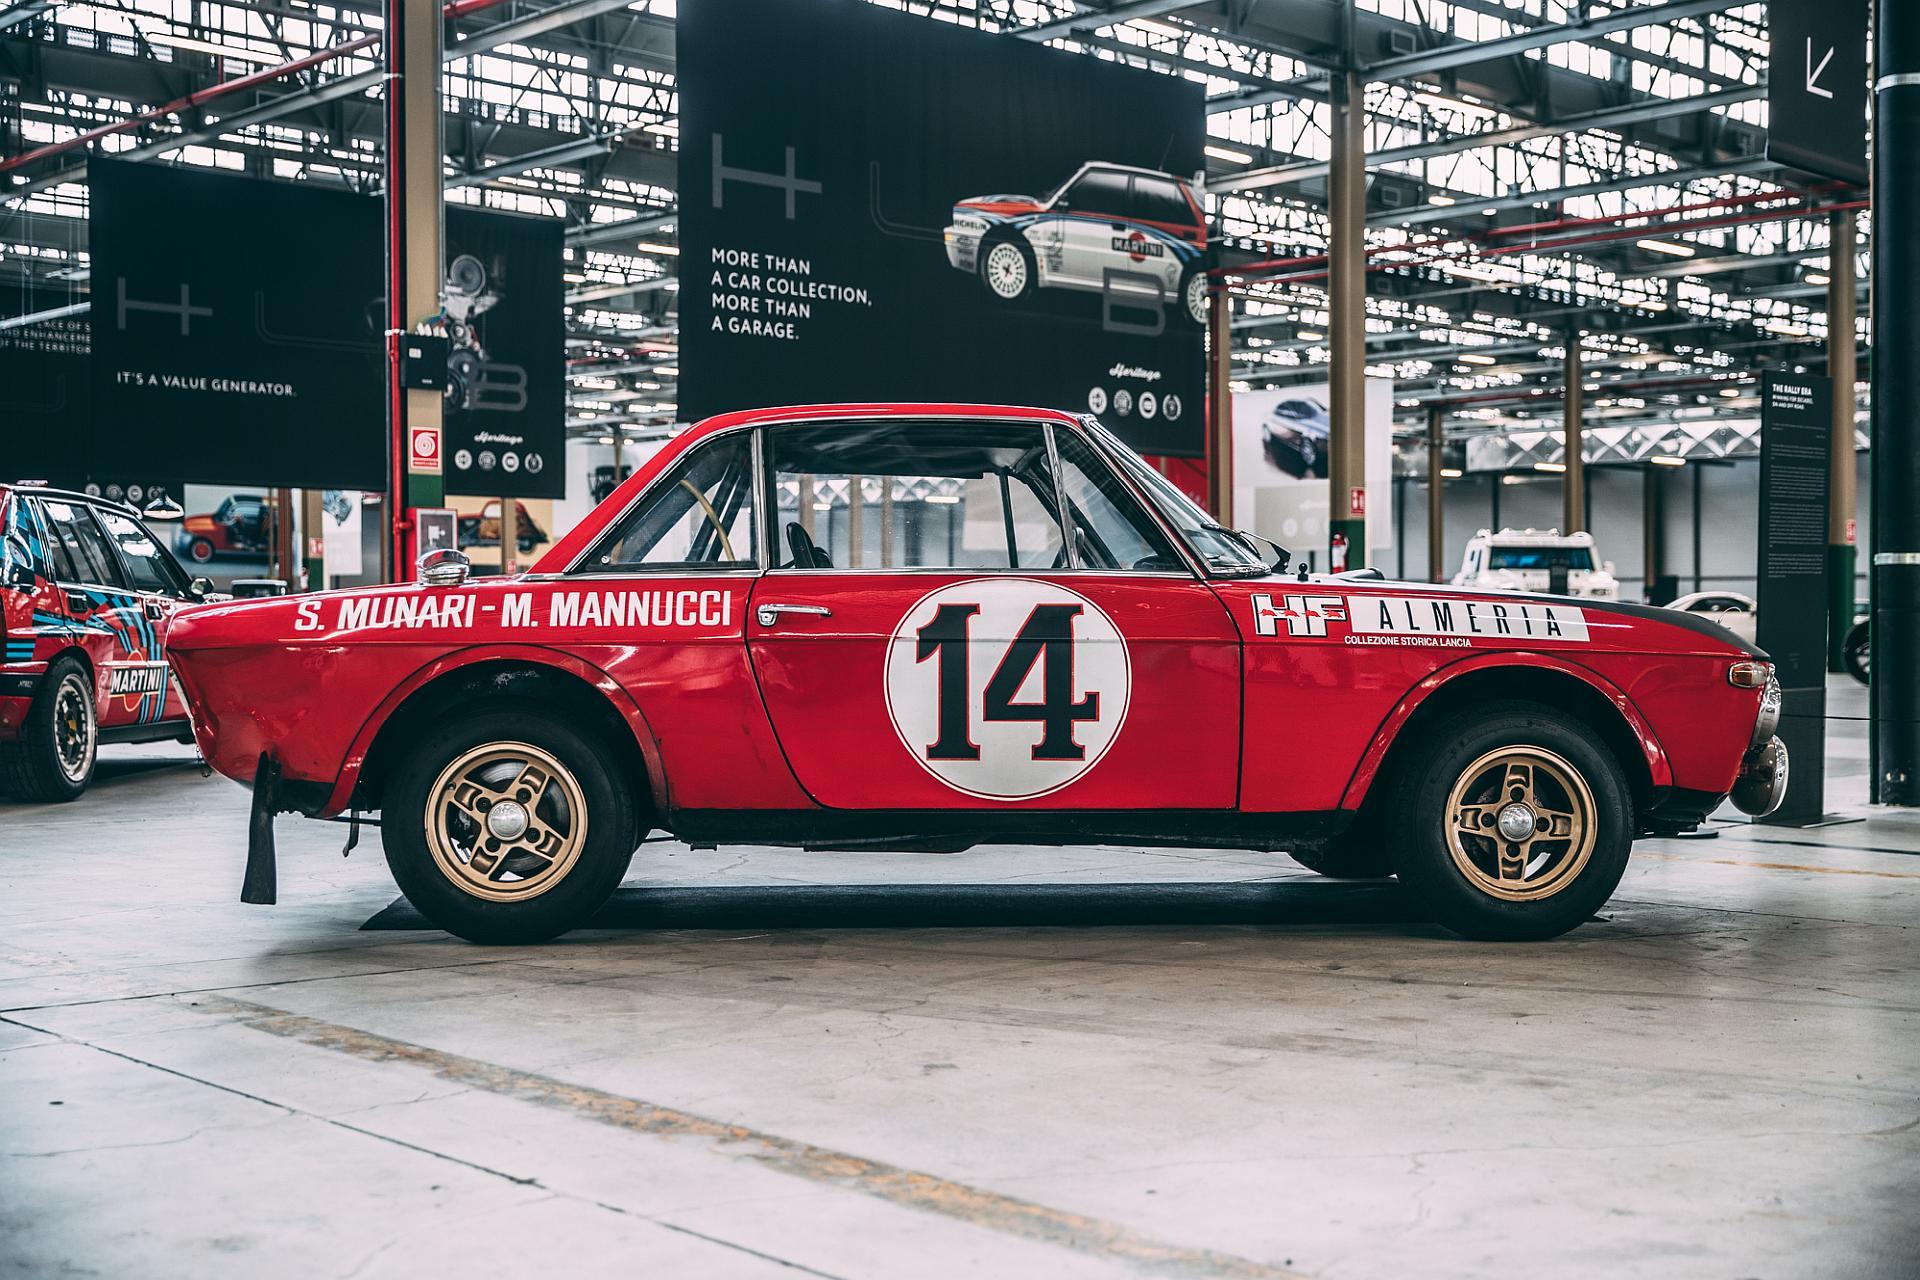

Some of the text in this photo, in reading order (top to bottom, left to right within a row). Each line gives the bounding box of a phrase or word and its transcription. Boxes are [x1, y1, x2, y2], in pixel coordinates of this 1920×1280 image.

[1113, 238, 1162, 257] MARTINI
[712, 248, 810, 275] MORE THAN
[711, 270, 872, 306] A CAR COLLECTION,
[712, 292, 810, 319] MORE THAN
[711, 315, 799, 340] A GARAGE.
[117, 371, 298, 396] IT'S A VALUE GENERATOR.
[1108, 362, 1161, 382] Heritage
[1772, 383, 1783, 393] THE
[1784, 385, 1800, 395] RALLY
[474, 431, 523, 446] Heritage
[294, 601, 325, 630] S.
[337, 595, 476, 630] MUNARI
[501, 594, 539, 627] M.
[549, 591, 731, 627] MANNUCCI
[1251, 594, 1562, 637] HF ALMERIA
[1344, 636, 1472, 648] COLLEZIONE STORICA LANCIA
[111, 669, 161, 692] MARTINI
[916, 603, 1100, 760] 14
